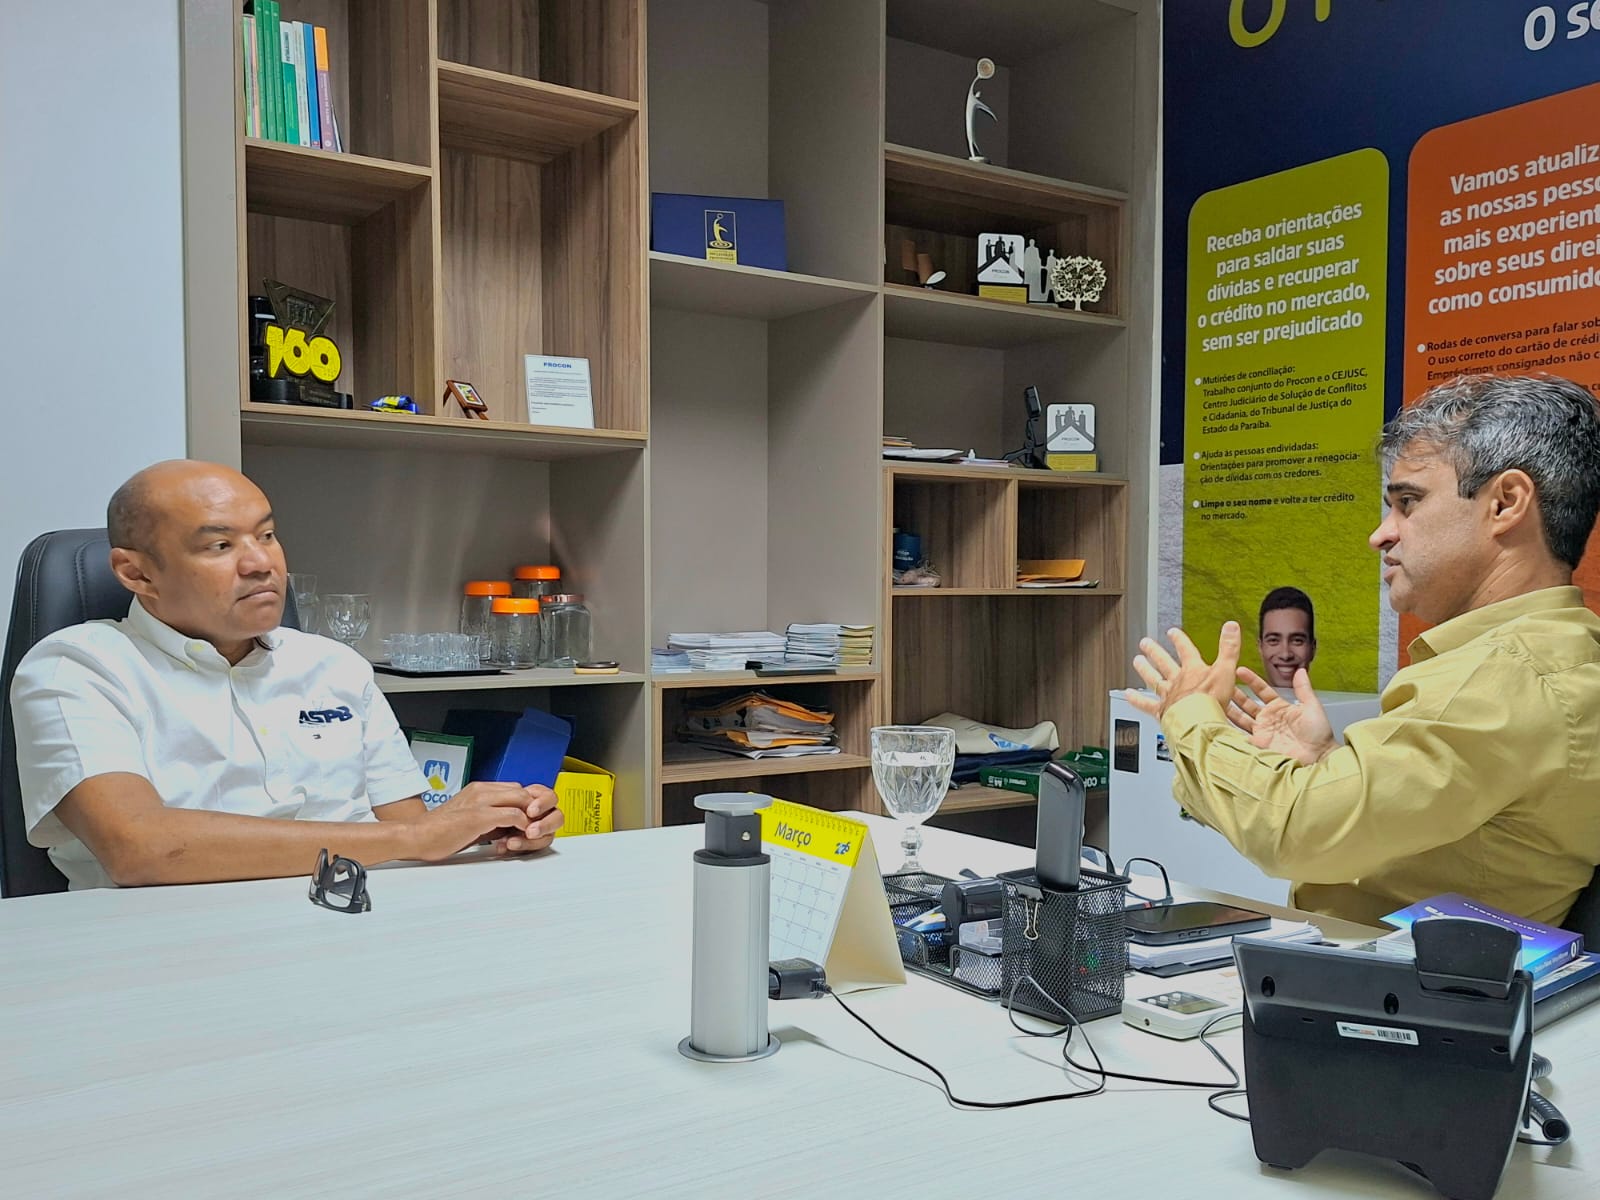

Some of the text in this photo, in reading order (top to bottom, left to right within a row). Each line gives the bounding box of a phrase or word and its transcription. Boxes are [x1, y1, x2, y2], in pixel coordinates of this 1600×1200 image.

[1524, 6, 1555, 51] O
[1450, 143, 1600, 195] Vamos atualiz
[1440, 208, 1462, 226] as
[1467, 191, 1537, 221] nossas
[1207, 203, 1362, 253] Receba orientações
[1444, 228, 1491, 254] mais
[1217, 234, 1344, 277] para saldar suas
[1435, 260, 1491, 285] sobre
[1497, 250, 1545, 273] seus
[1208, 258, 1359, 301] dívidas e recuperar
[1198, 284, 1370, 328] o crédito no mercado,
[1429, 291, 1482, 314] como
[1202, 310, 1363, 351] sem ser prejudicado
[1427, 340, 1457, 351] Rodas
[1460, 338, 1472, 346] de
[1476, 330, 1522, 345] conversa
[1525, 327, 1550, 339] para
[1553, 321, 1579, 333] falar
[1428, 357, 1436, 366] O
[1438, 355, 1455, 364] uso
[1459, 349, 1495, 362] correto
[1498, 348, 1511, 356] do
[1515, 341, 1550, 354] cartão
[1553, 338, 1567, 349] de
[1497, 355, 1565, 371] consignados
[1569, 352, 1590, 362] não
[1203, 384, 1235, 397] Trabalho
[1237, 381, 1272, 393] conjunto
[1274, 379, 1285, 388] do
[1286, 377, 1315, 387] Procon
[1237, 372, 1247, 381] de
[1248, 365, 1295, 379] conciliação:
[1203, 382, 1367, 410] Centro Judiciário de Solução de Conflitos
[1262, 405, 1294, 415] Tribunal
[1297, 403, 1307, 412] de
[1309, 399, 1339, 410] Justiça
[1340, 397, 1352, 407] do
[1202, 425, 1228, 434] Estado
[1229, 423, 1239, 432] da
[1200, 461, 1244, 473] Orientações
[1246, 461, 1263, 470] para
[1266, 457, 1305, 468] promover
[1201, 451, 1223, 460] Ajuda
[1234, 448, 1264, 458] pessoas
[1266, 442, 1319, 453] endividadas:
[1214, 474, 1224, 483] de
[1255, 472, 1272, 480] com
[1284, 469, 1321, 478] credores.
[1201, 500, 1224, 509] Limpe
[1280, 494, 1301, 504] volte
[1323, 492, 1354, 503] crédito
[1212, 511, 1248, 520] mercado.
[593, 791, 603, 833] Arquivo
[774, 820, 812, 848] Março
